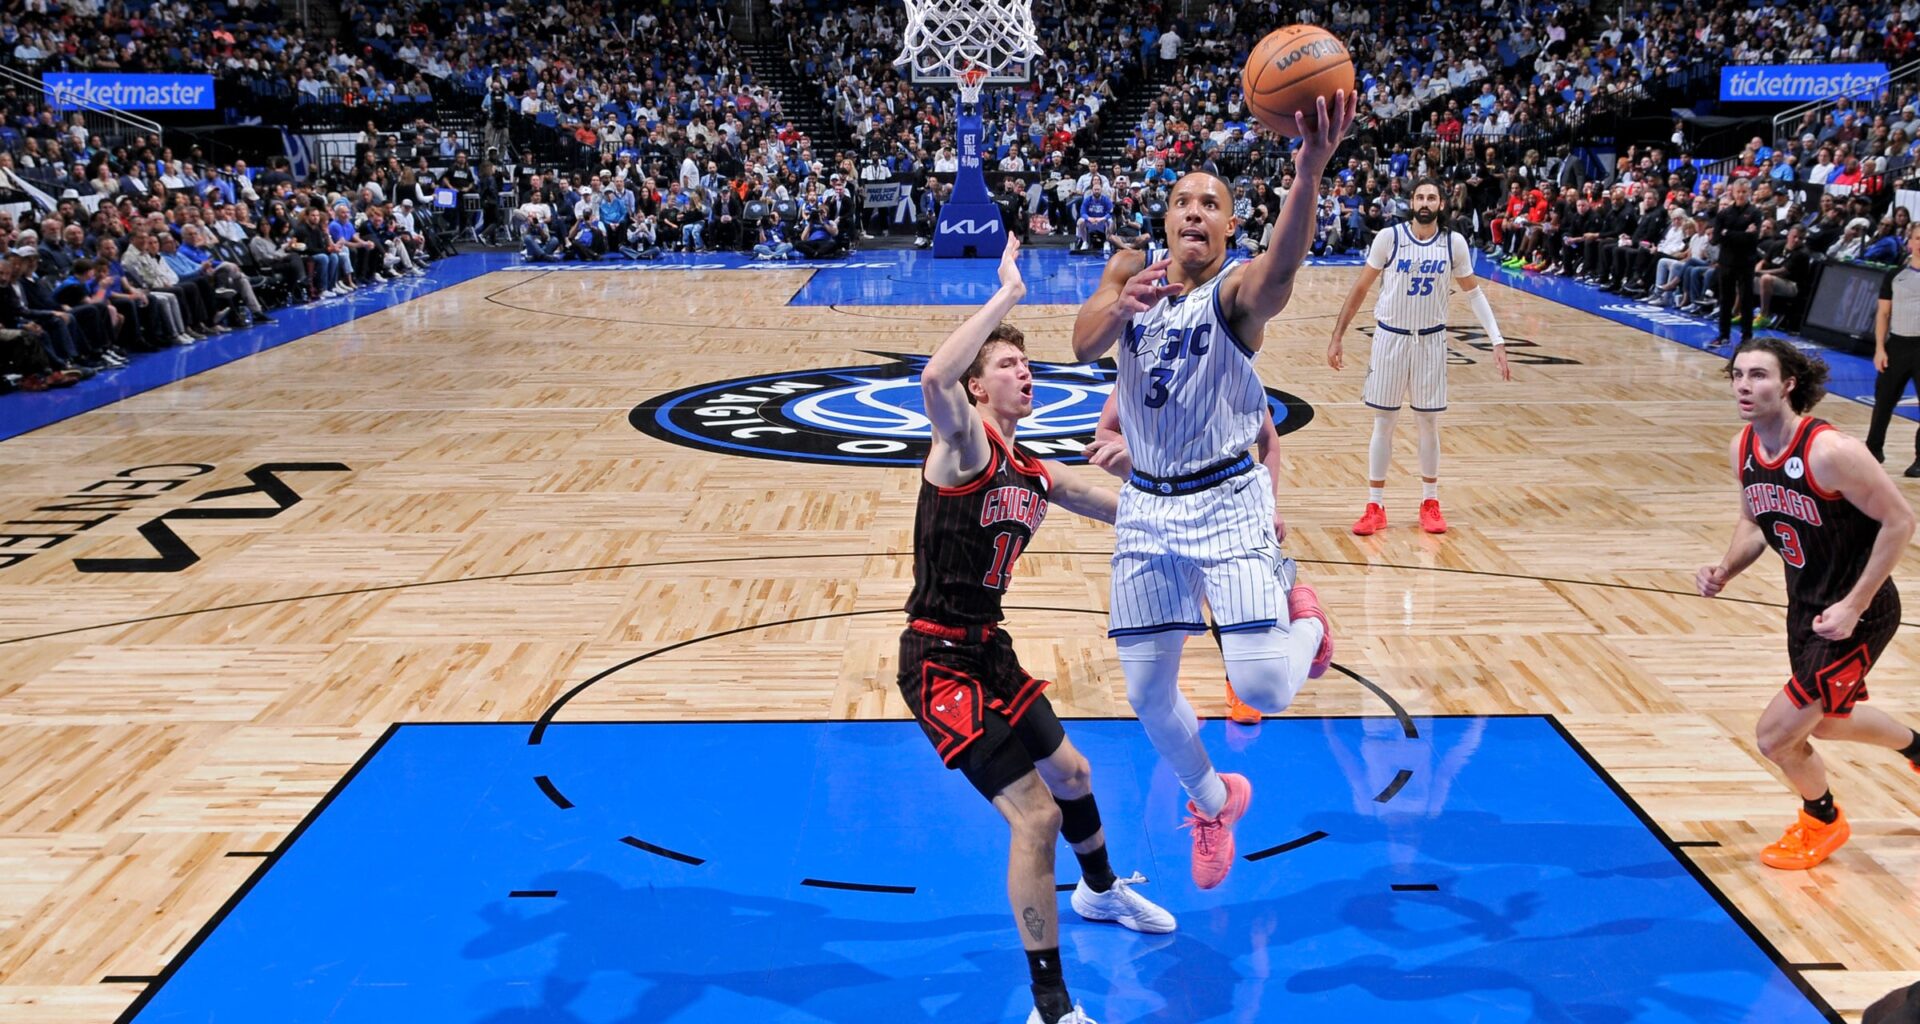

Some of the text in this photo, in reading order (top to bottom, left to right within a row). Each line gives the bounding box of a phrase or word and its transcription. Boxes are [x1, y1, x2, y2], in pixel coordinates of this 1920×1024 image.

[1276, 38, 1343, 71] Wilson
[54, 78, 204, 105] ticketmaster
[1730, 70, 1881, 96] ticketmaster
[963, 134, 976, 145] GET
[964, 145, 976, 156] THE
[869, 192, 895, 202] NOISE
[940, 219, 999, 234] KIA
[1407, 277, 1435, 296] 35
[1144, 368, 1175, 409] 3
[693, 380, 825, 440] MAGIC
[980, 485, 1048, 534] CHICAG
[1743, 483, 1823, 527] CHICAGO
[1773, 520, 1806, 569] 3
